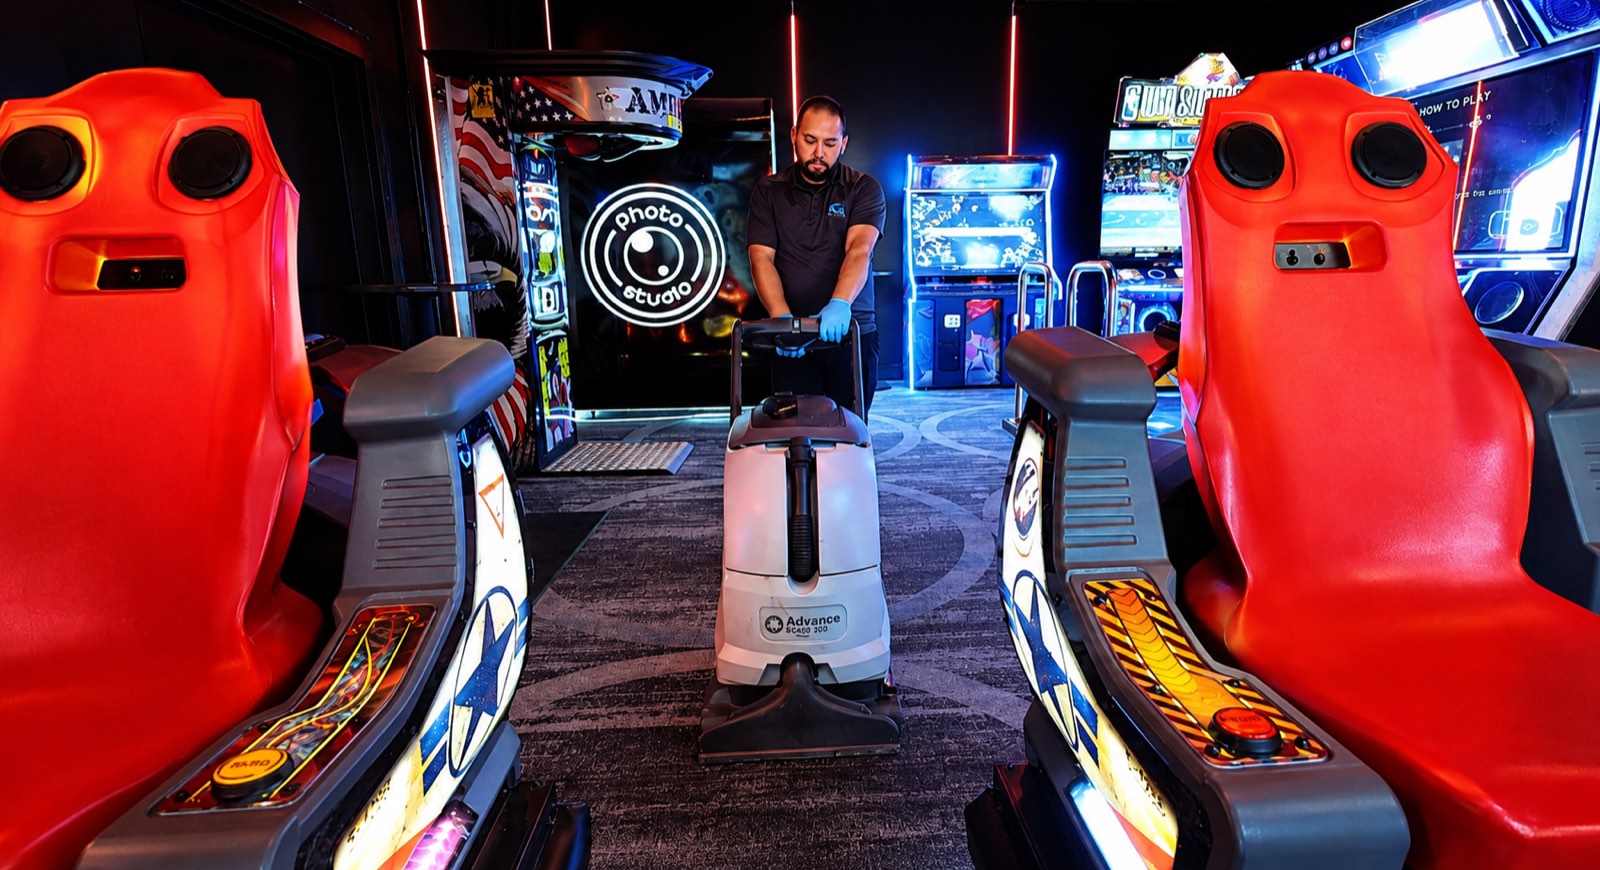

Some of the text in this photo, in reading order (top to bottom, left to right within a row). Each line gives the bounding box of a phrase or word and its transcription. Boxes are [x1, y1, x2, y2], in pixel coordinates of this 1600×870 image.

[1420, 91, 1491, 116] HOW TO PLAY
[615, 204, 684, 232] photo
[623, 281, 692, 307] studio
[786, 615, 841, 626] Advance
